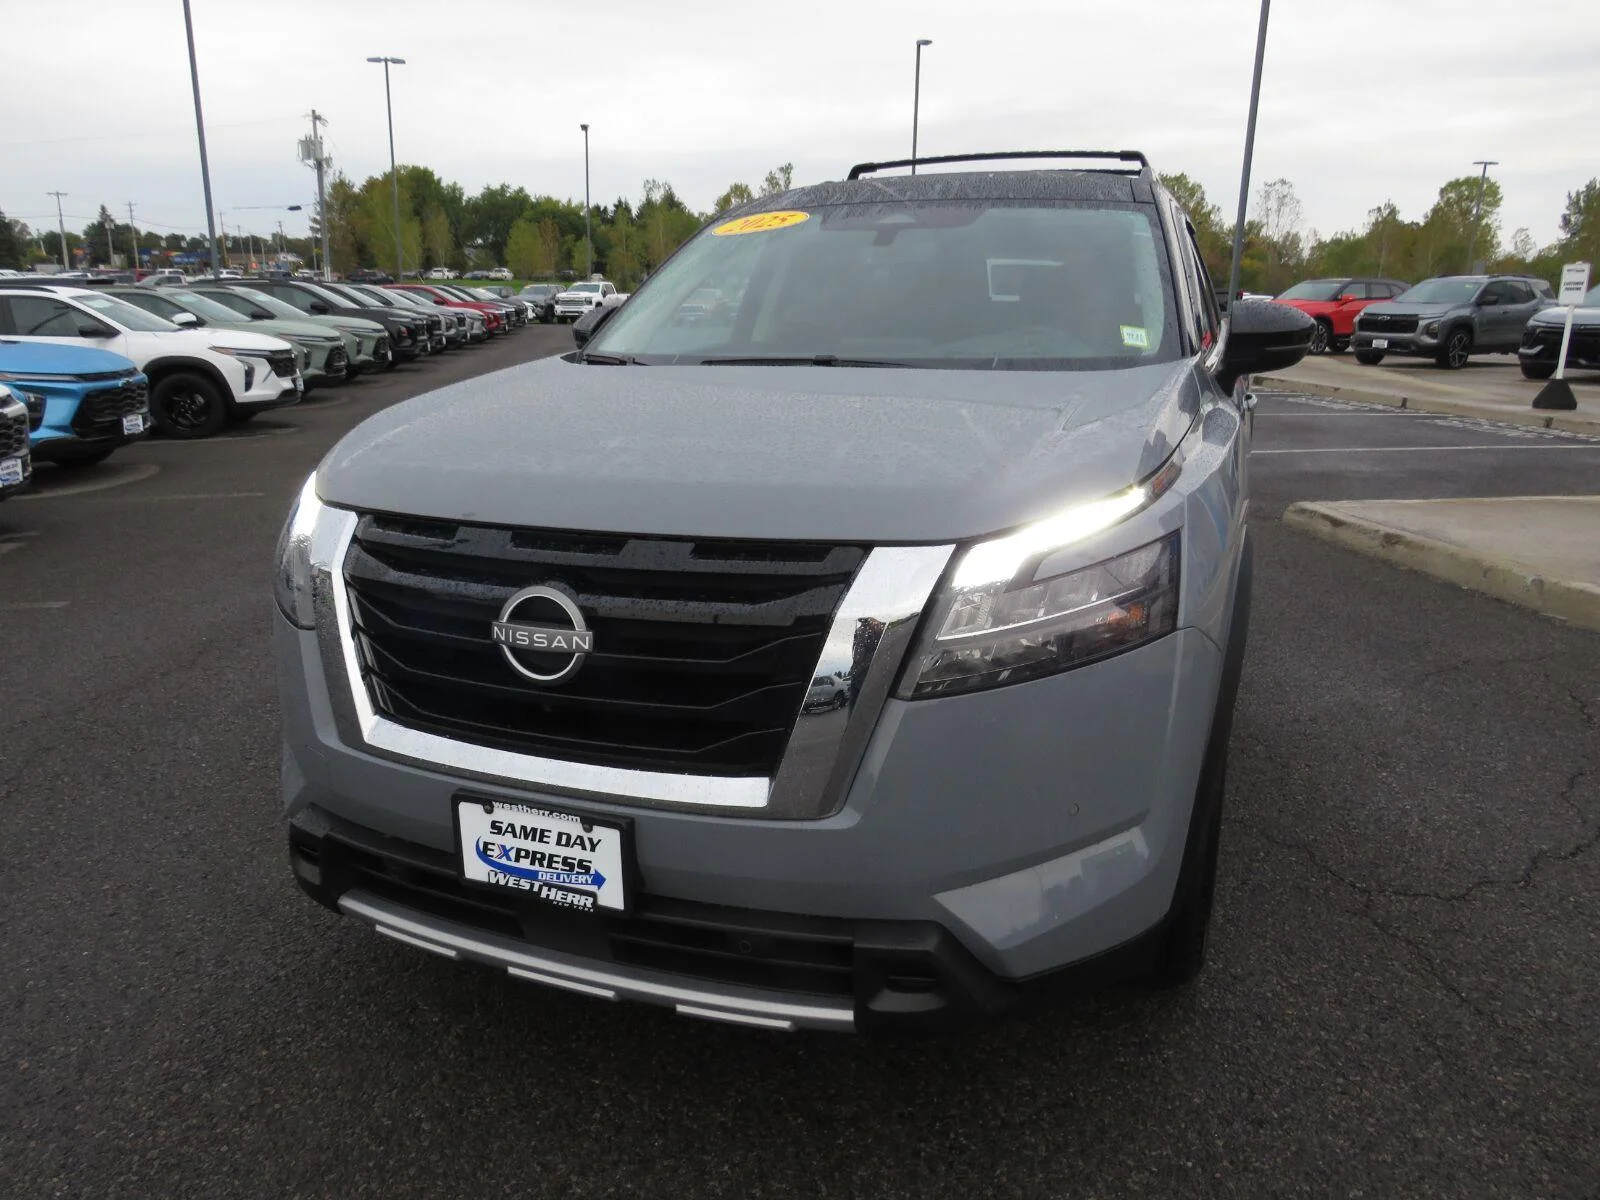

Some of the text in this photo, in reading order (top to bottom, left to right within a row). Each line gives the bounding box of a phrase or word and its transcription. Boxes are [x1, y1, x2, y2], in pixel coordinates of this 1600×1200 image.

[493, 626, 589, 650] NISSAN
[492, 800, 581, 822] westherr.com
[489, 820, 602, 852] SAME DAY
[482, 840, 593, 875] EXPRESS
[538, 871, 594, 885] DELIVERY
